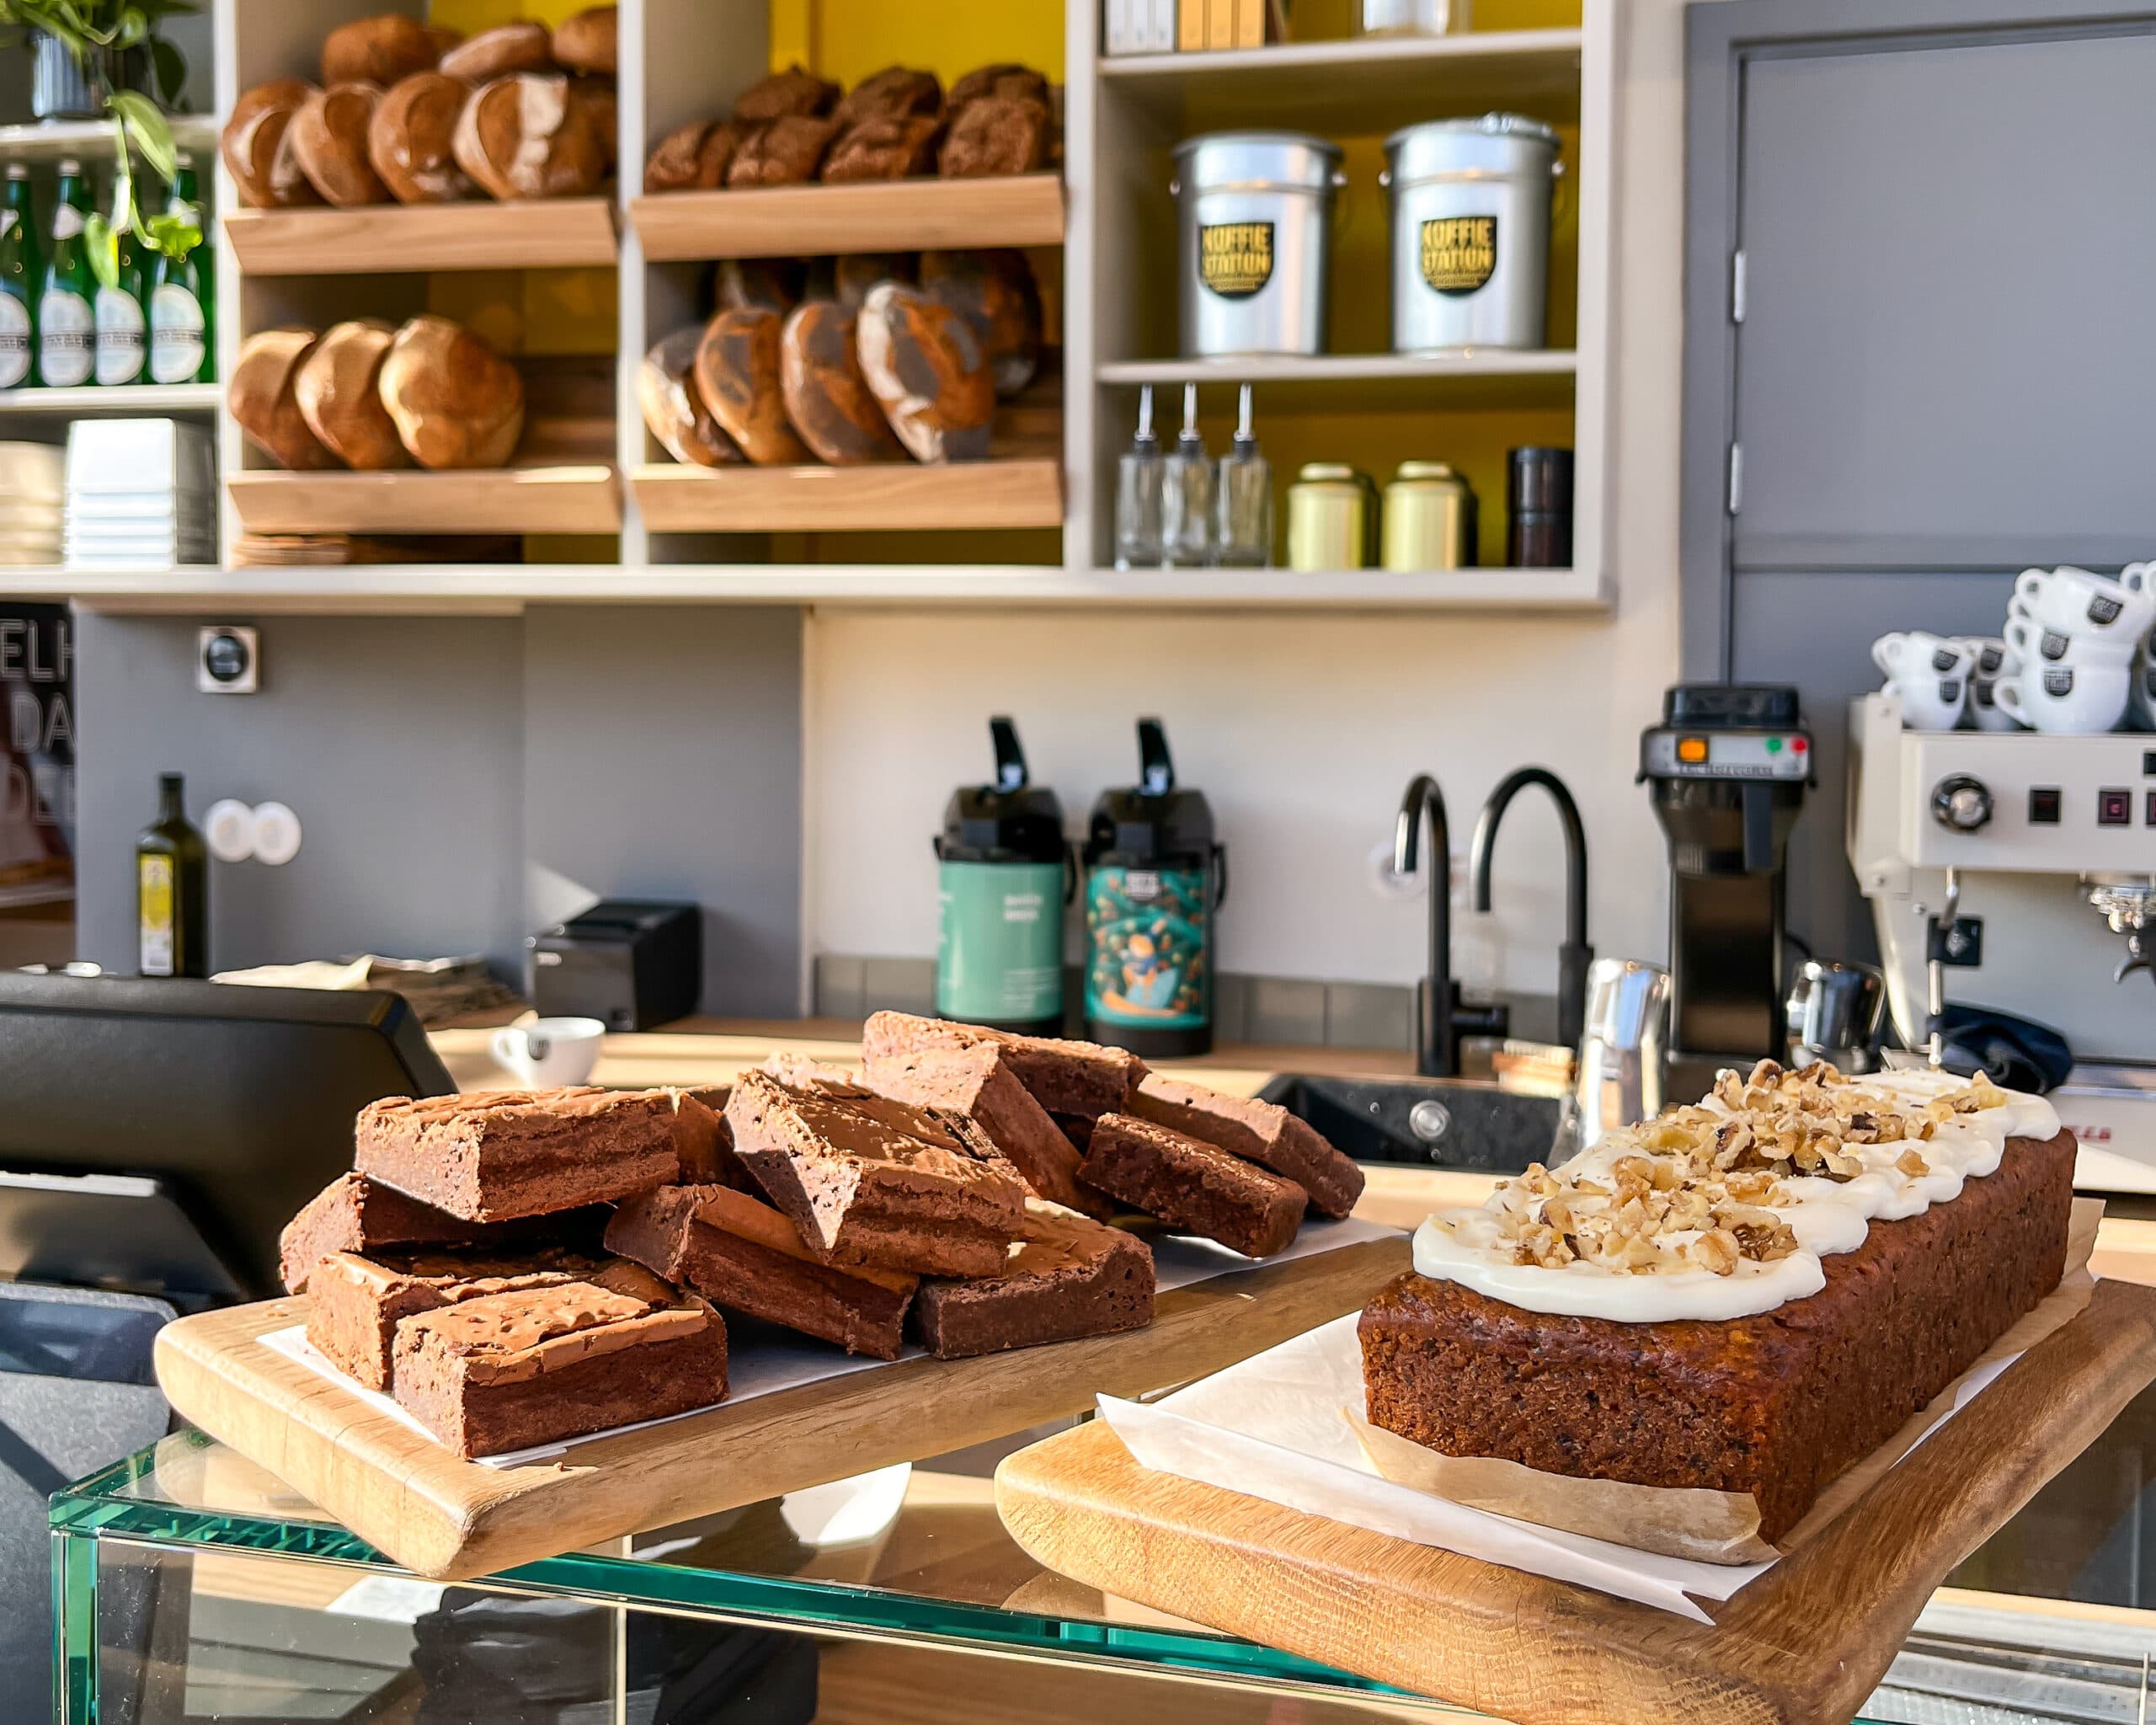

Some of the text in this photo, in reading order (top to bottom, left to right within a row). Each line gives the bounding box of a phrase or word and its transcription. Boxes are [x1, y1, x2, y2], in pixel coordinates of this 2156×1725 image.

[1203, 225, 1268, 254] KOFFIE
[1422, 219, 1491, 248] KOFFIE
[1204, 253, 1270, 277] STATION
[1422, 248, 1492, 273] STATION
